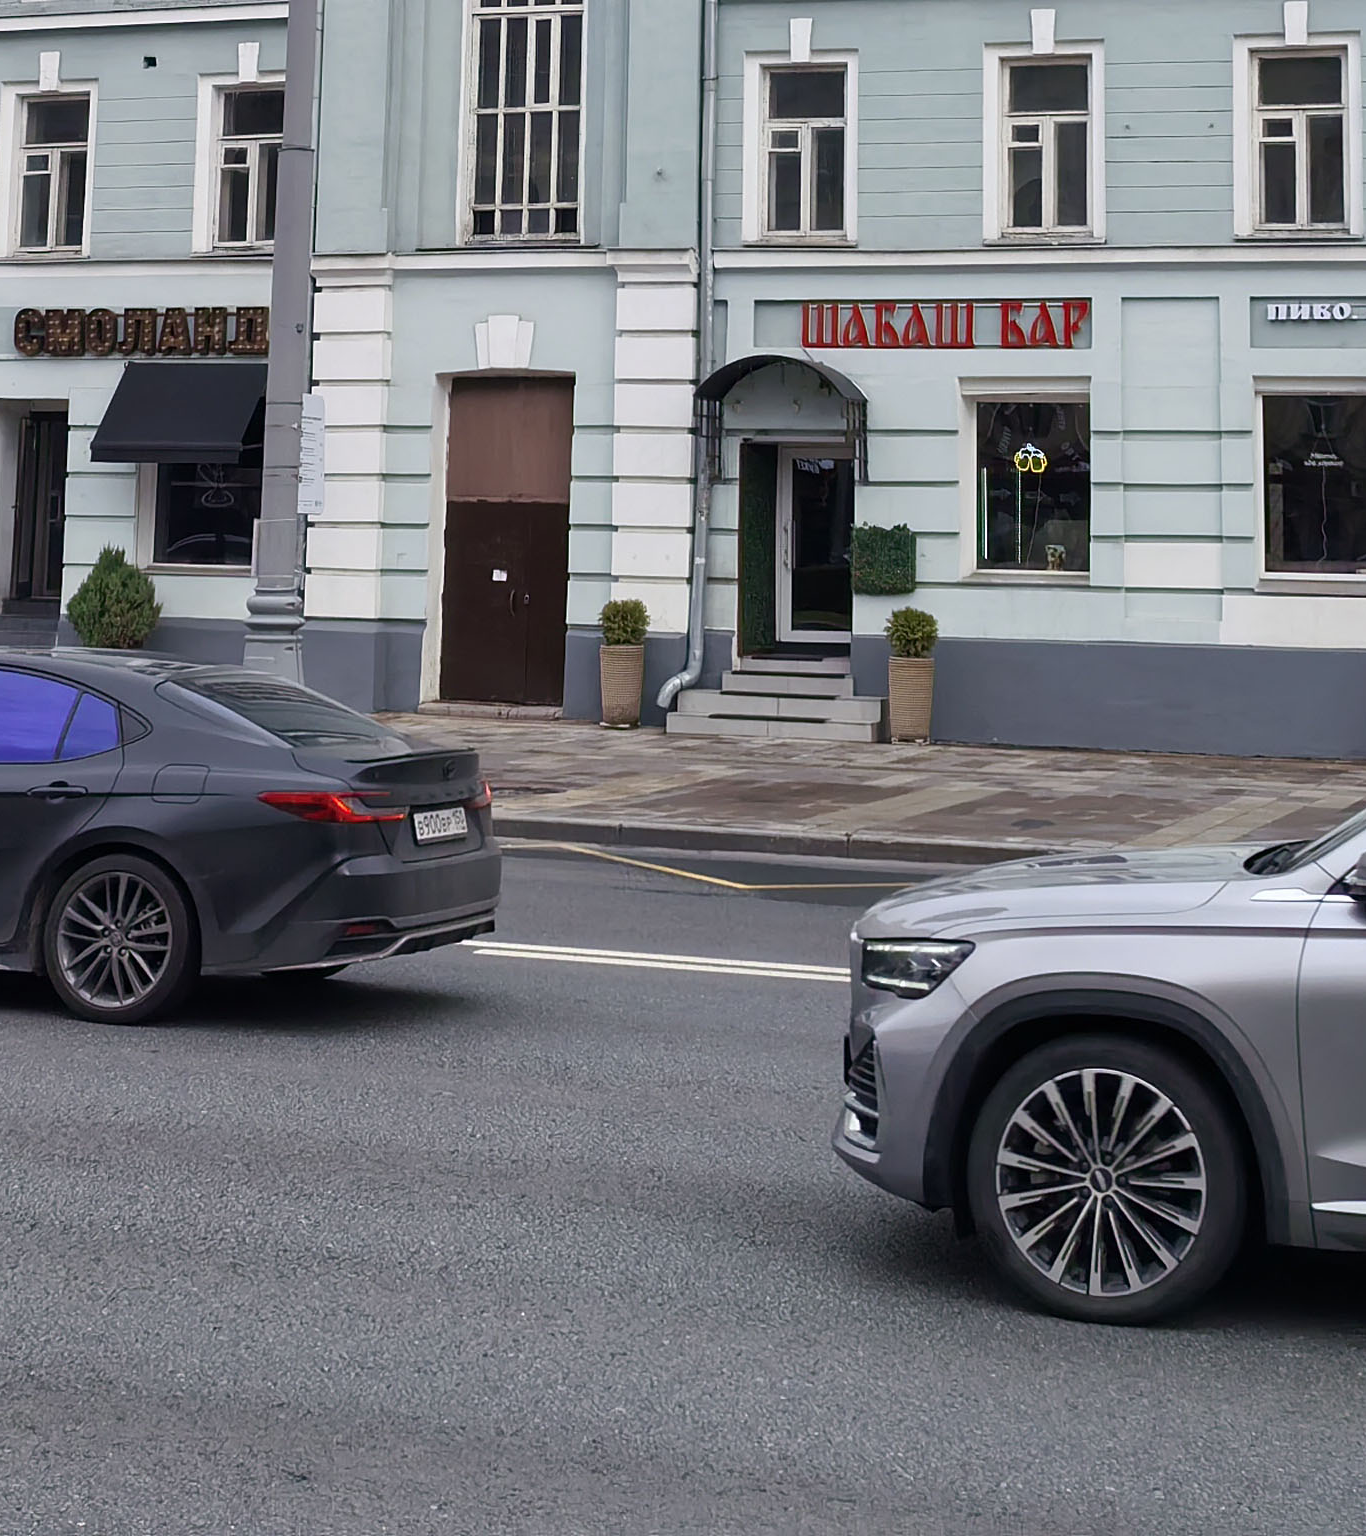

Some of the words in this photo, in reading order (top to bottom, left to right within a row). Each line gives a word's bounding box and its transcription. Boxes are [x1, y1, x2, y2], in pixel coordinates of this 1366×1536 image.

[14, 307, 270, 357] СМОЛАНД
[801, 301, 976, 349] ШАБАШ
[999, 300, 1091, 349] БАР
